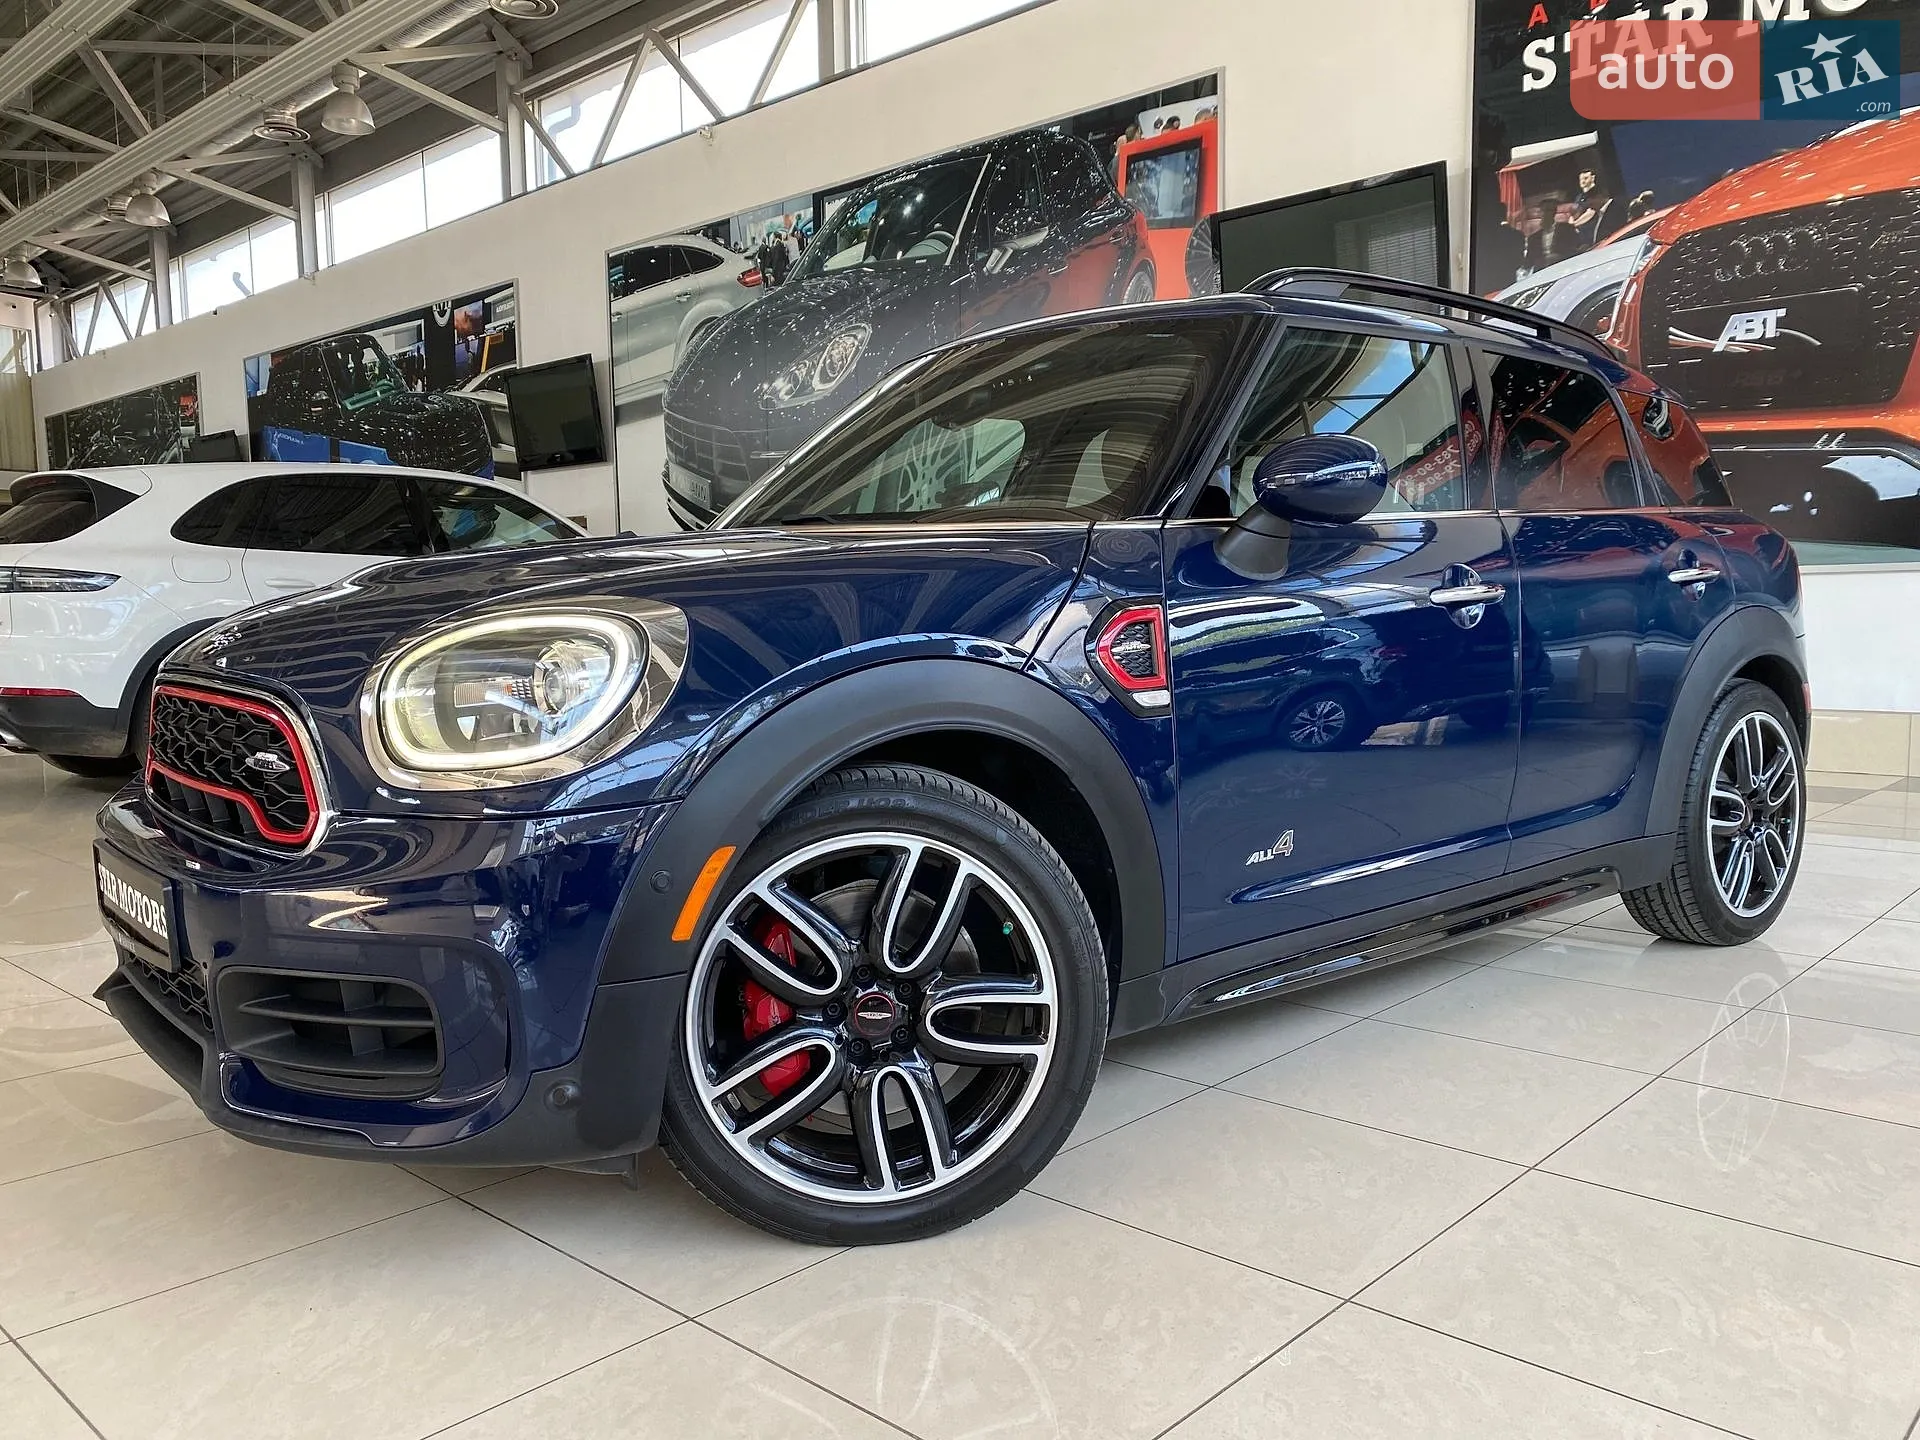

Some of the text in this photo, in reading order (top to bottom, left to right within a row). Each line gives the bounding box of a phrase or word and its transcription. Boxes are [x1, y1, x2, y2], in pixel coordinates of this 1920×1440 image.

[1522, 0, 1713, 92] STAR
[1713, 308, 1787, 352] ABT
[98, 862, 169, 940] STAR MOTORS
